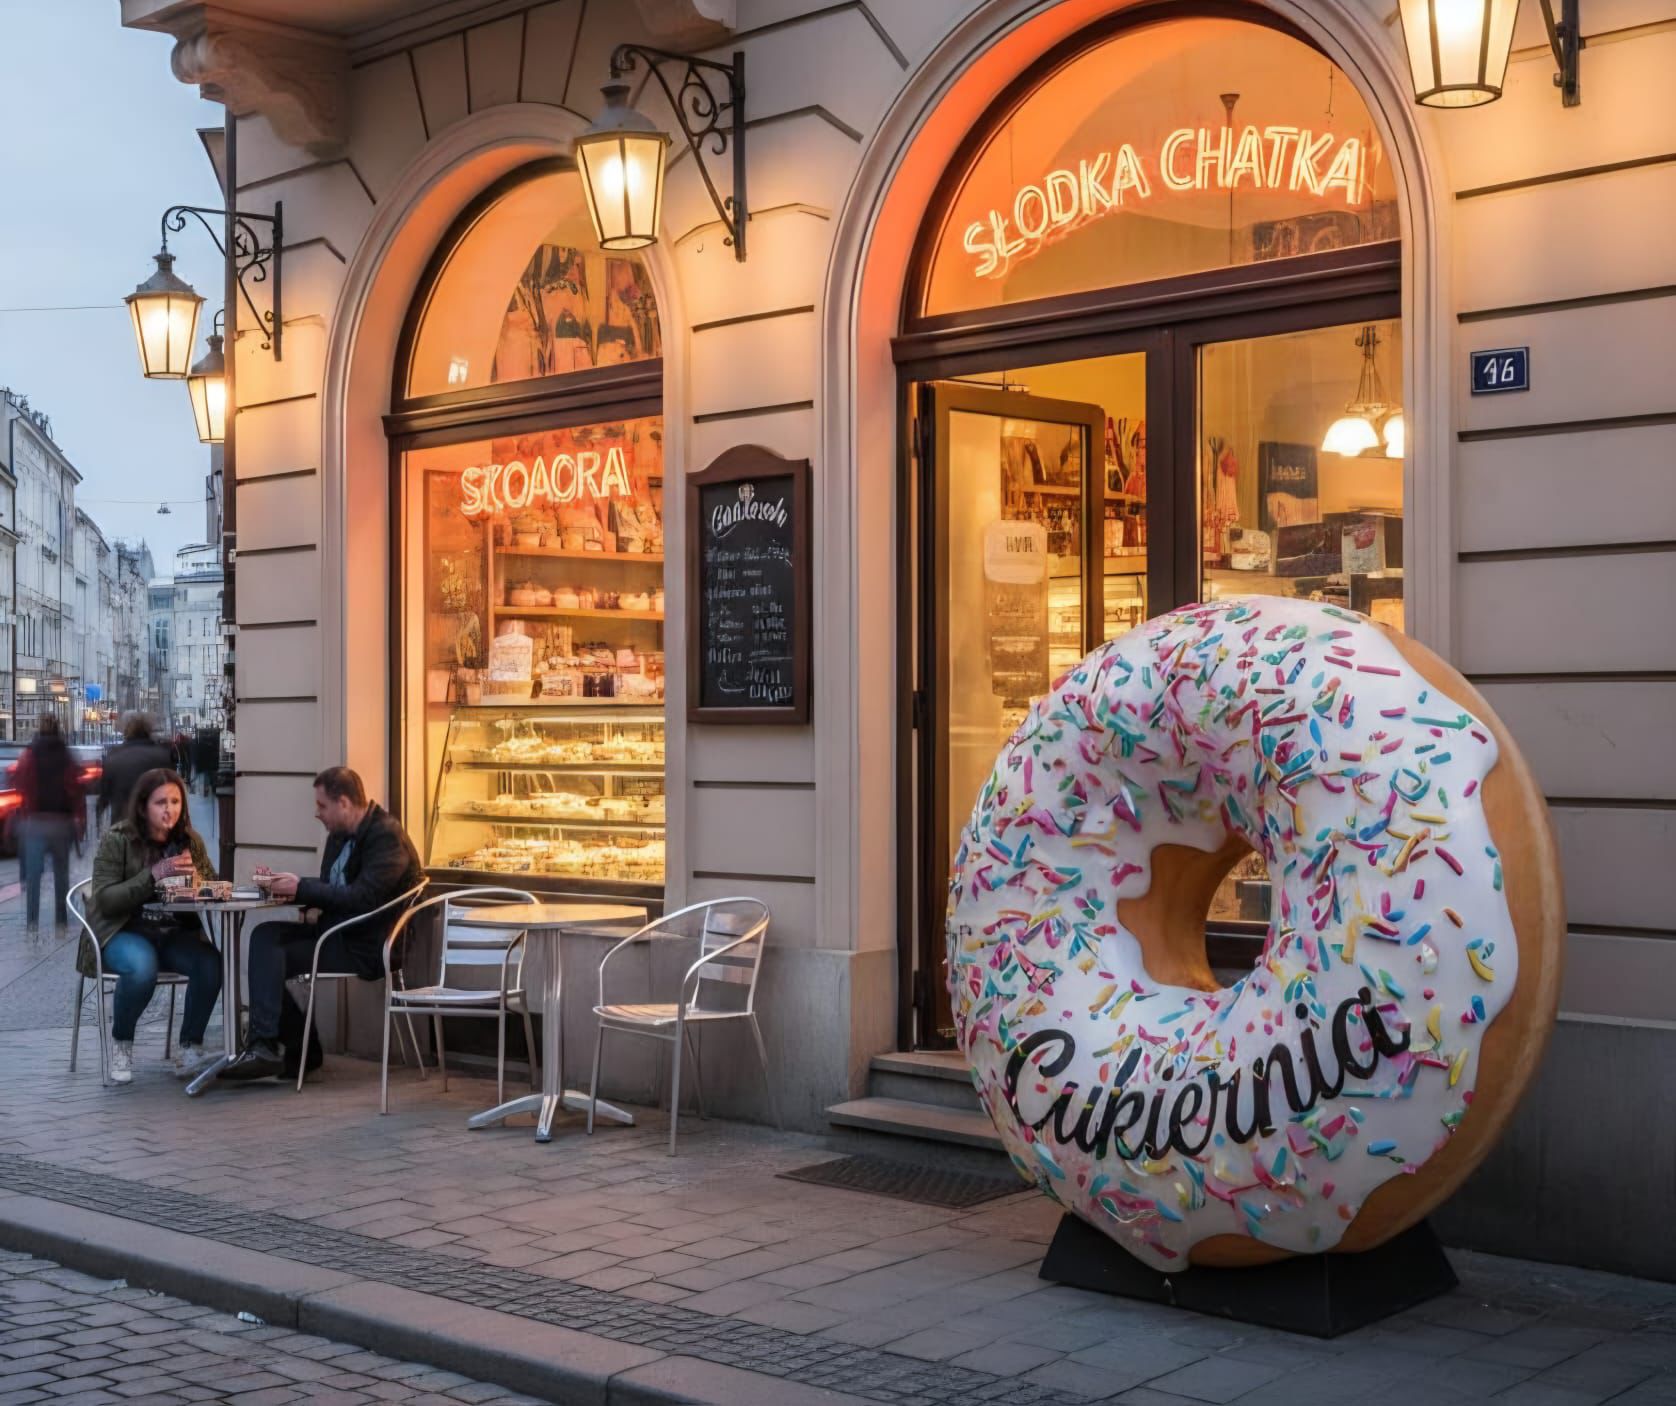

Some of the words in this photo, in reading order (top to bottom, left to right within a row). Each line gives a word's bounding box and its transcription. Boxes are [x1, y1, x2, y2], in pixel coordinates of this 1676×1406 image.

[964, 143, 1150, 278] SŁODKA
[1159, 125, 1365, 205] CHATKA
[1483, 357, 1514, 385] 16
[1005, 986, 1411, 1160] Cukiernia
